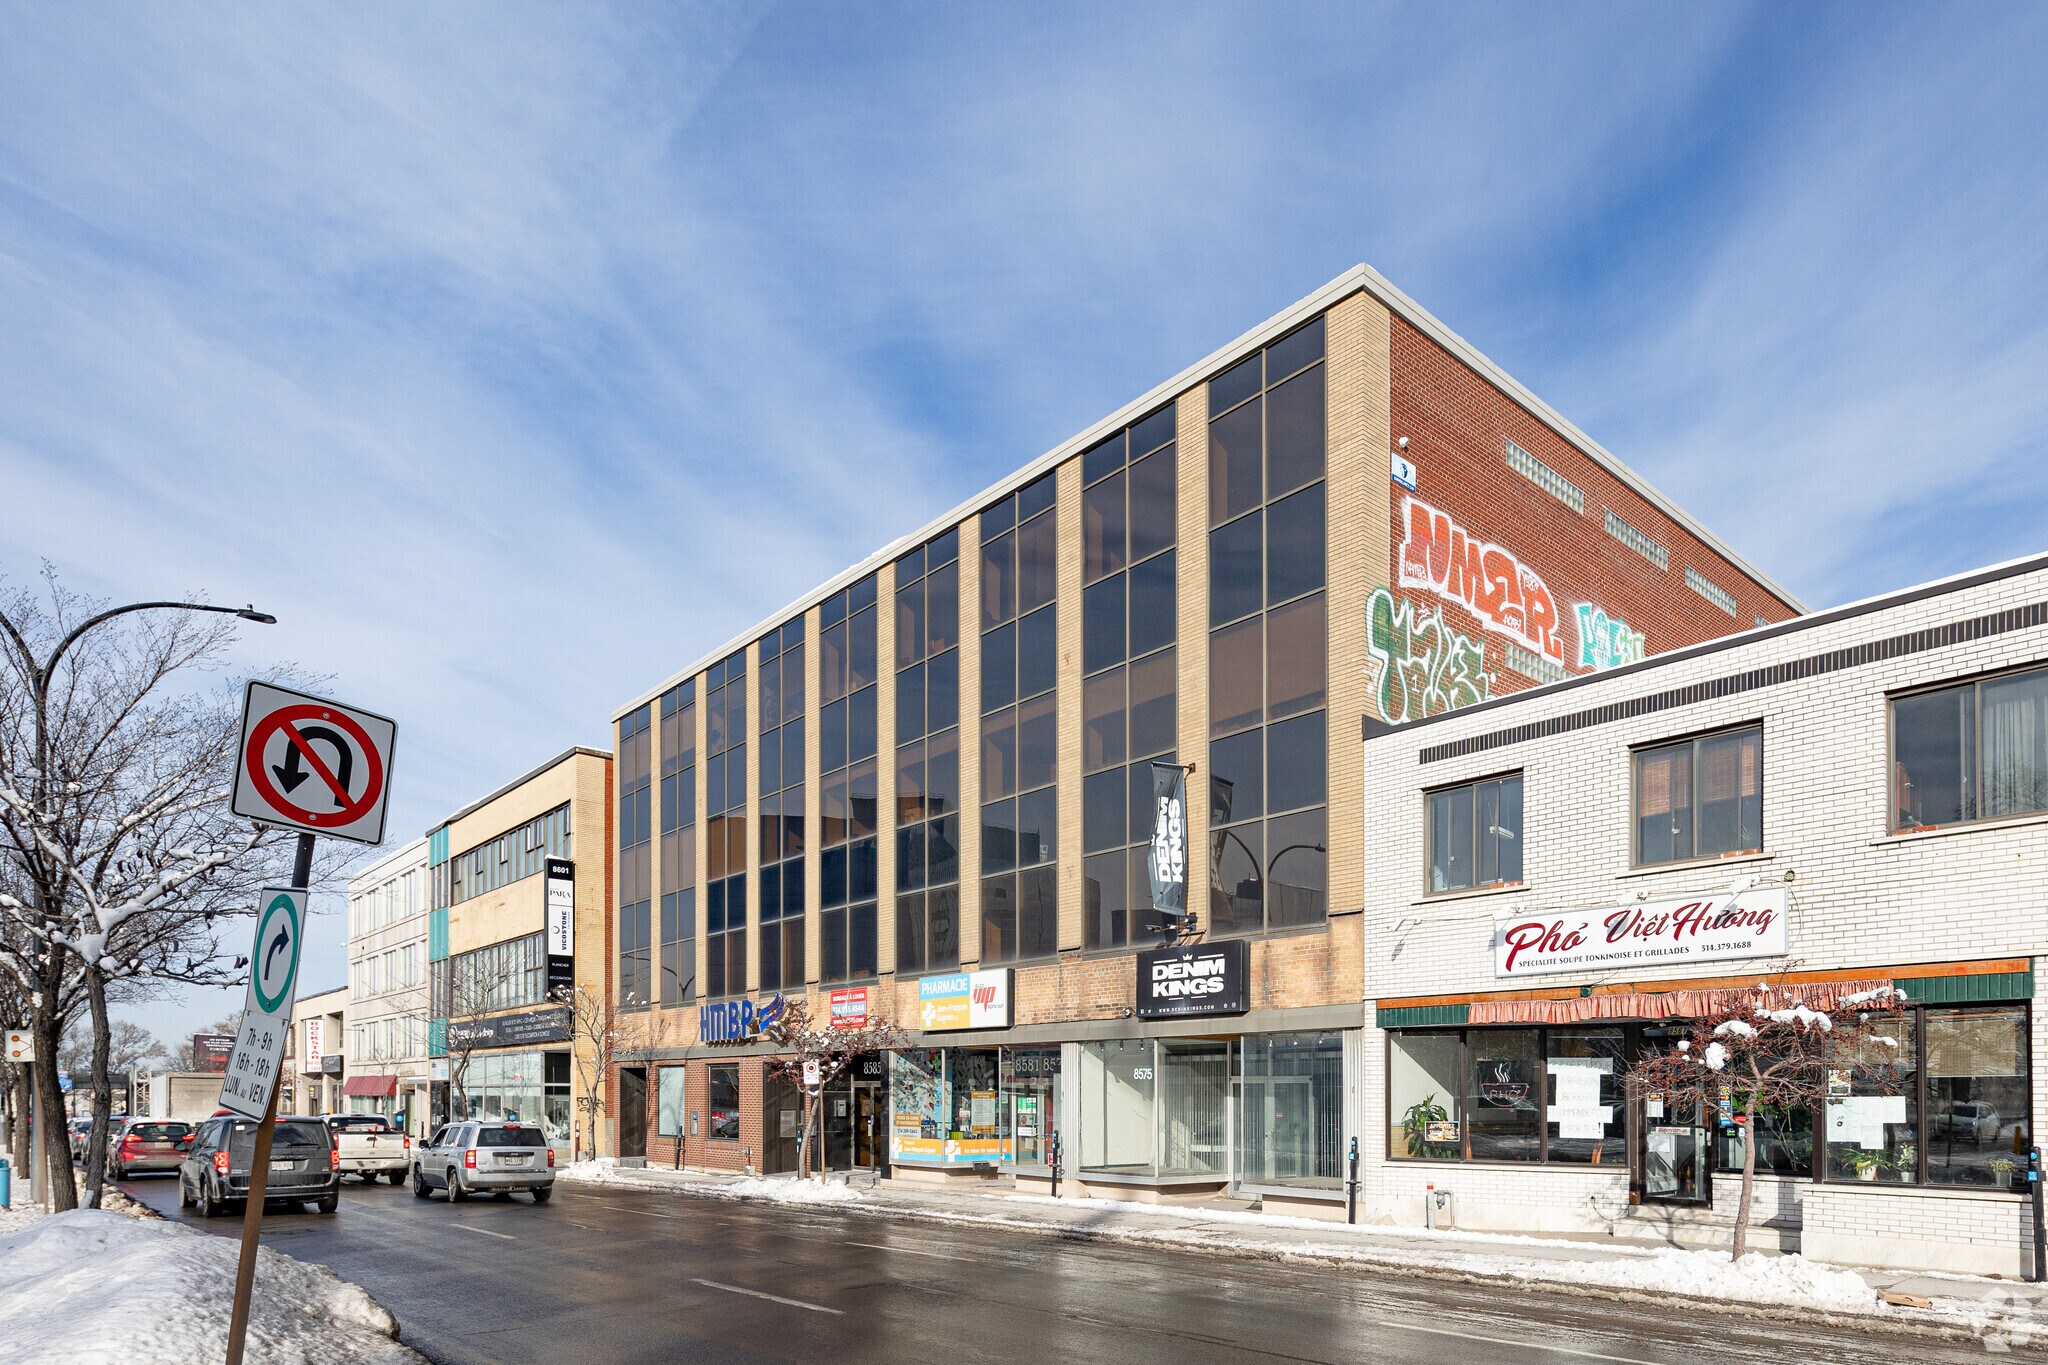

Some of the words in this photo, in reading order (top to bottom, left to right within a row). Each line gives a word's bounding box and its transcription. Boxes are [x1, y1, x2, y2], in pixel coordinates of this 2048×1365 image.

[1156, 796, 1171, 883] DENIM
[1168, 798, 1183, 883] KINGS
[552, 865, 569, 874] 8601
[549, 889, 571, 899] PARA
[1559, 955, 1583, 965] SOUPE
[1585, 951, 1632, 962] TONKINOISE
[1634, 950, 1642, 958] ET
[1645, 946, 1690, 957] GRILLADES
[1701, 941, 1752, 953] 514.379.1688
[1152, 958, 1226, 981] DENIM
[921, 977, 968, 996] PHARMACIE
[1152, 976, 1225, 998] KINGS
[246, 1028, 257, 1047] 7h
[261, 1031, 273, 1052] 9h
[310, 1021, 319, 1060] ROCKSTAR
[235, 1051, 250, 1072] 16h
[254, 1056, 270, 1079] 18h
[863, 1061, 881, 1075] 8585
[1015, 1058, 1040, 1072] 8581
[1133, 1067, 1153, 1080] 8575
[224, 1074, 241, 1097] LUN.
[248, 1082, 267, 1106] VEN.
